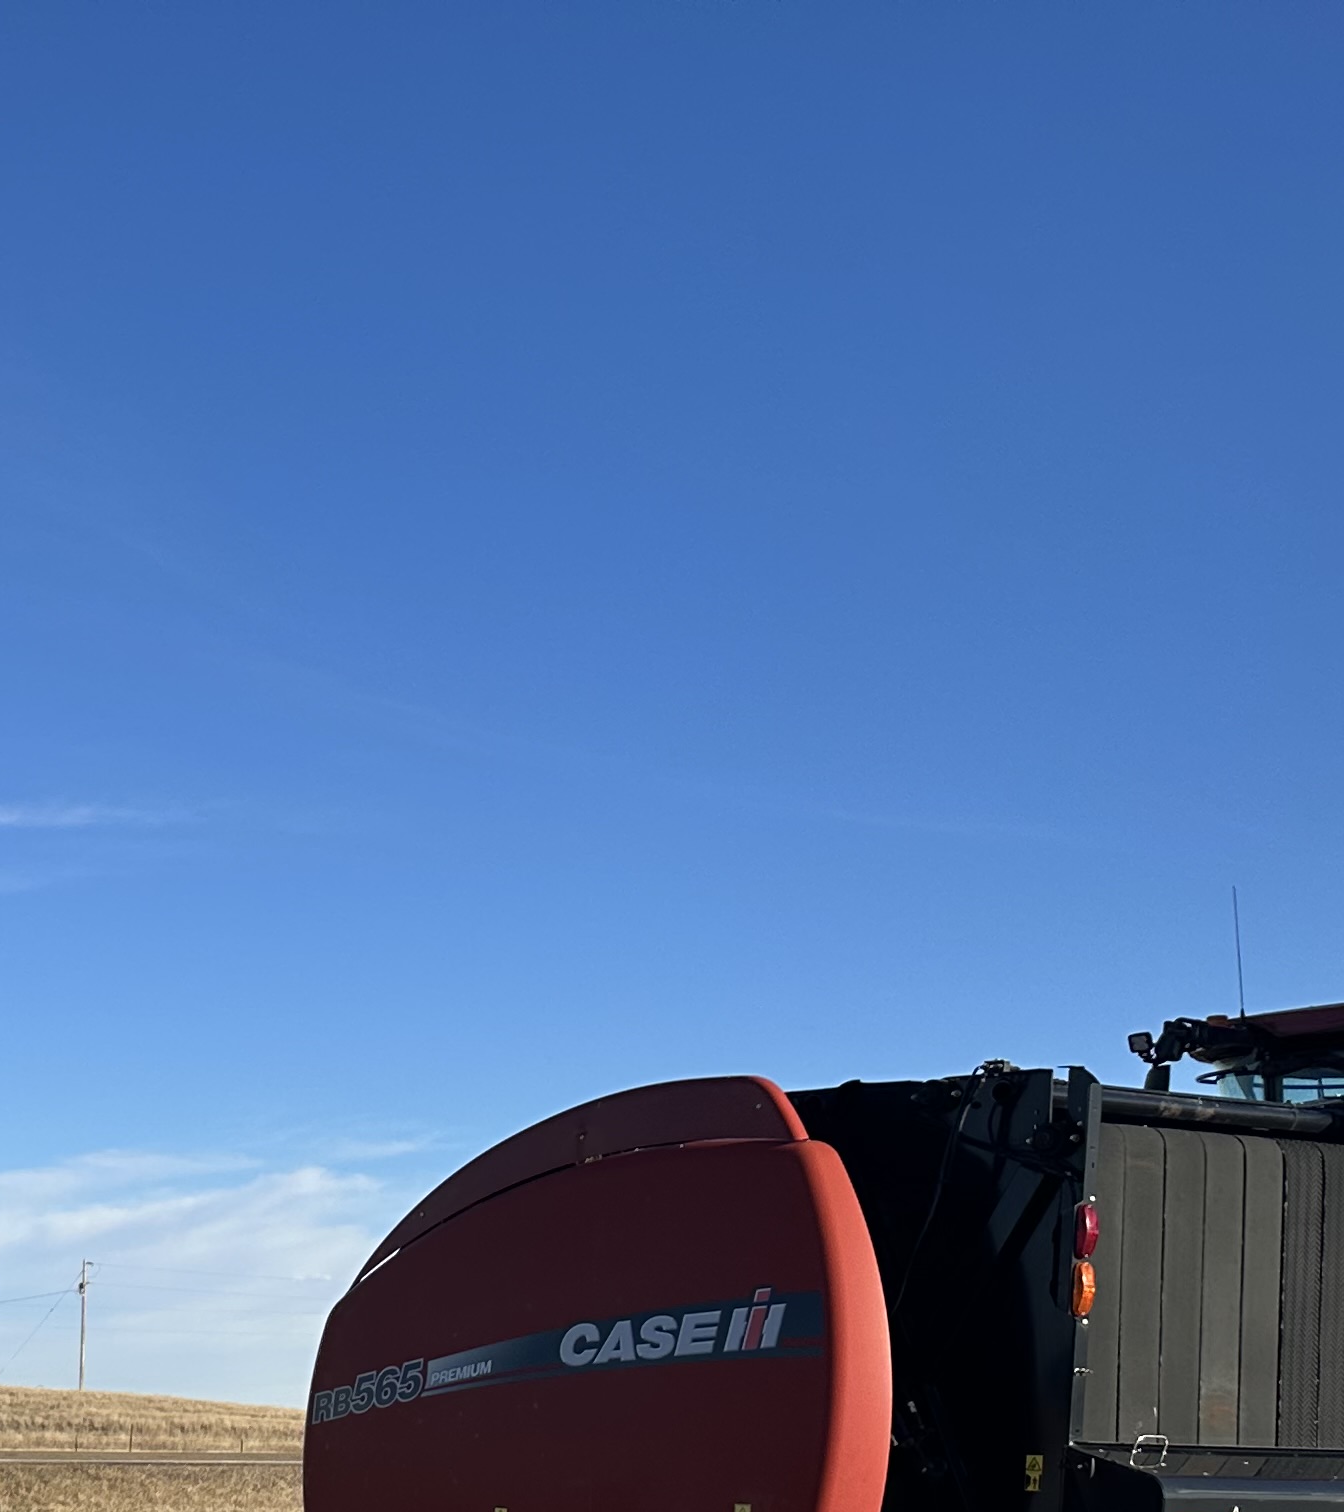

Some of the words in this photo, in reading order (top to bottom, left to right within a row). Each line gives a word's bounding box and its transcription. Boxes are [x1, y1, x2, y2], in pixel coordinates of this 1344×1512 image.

[559, 1310, 722, 1367] CASE
[312, 1358, 424, 1424] RB565
[430, 1359, 493, 1386] PREMIUM
